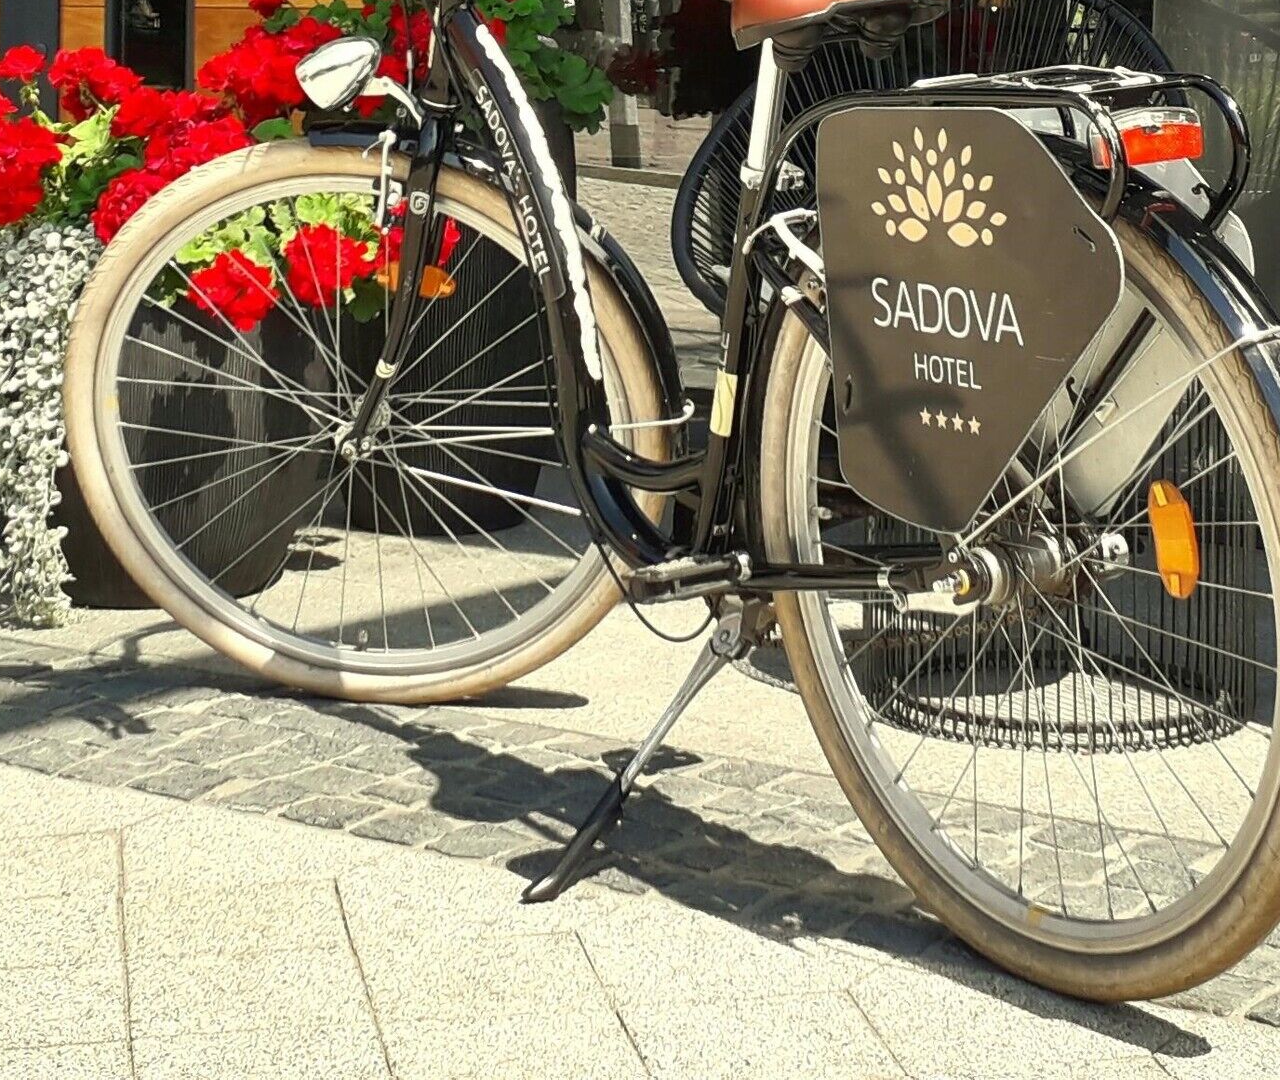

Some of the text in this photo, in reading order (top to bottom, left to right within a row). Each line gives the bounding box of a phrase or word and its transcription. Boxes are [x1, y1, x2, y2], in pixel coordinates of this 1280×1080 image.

[519, 194, 551, 285] HOTEL
[870, 277, 1024, 347] SADOVA
[913, 352, 982, 390] HOTEL
